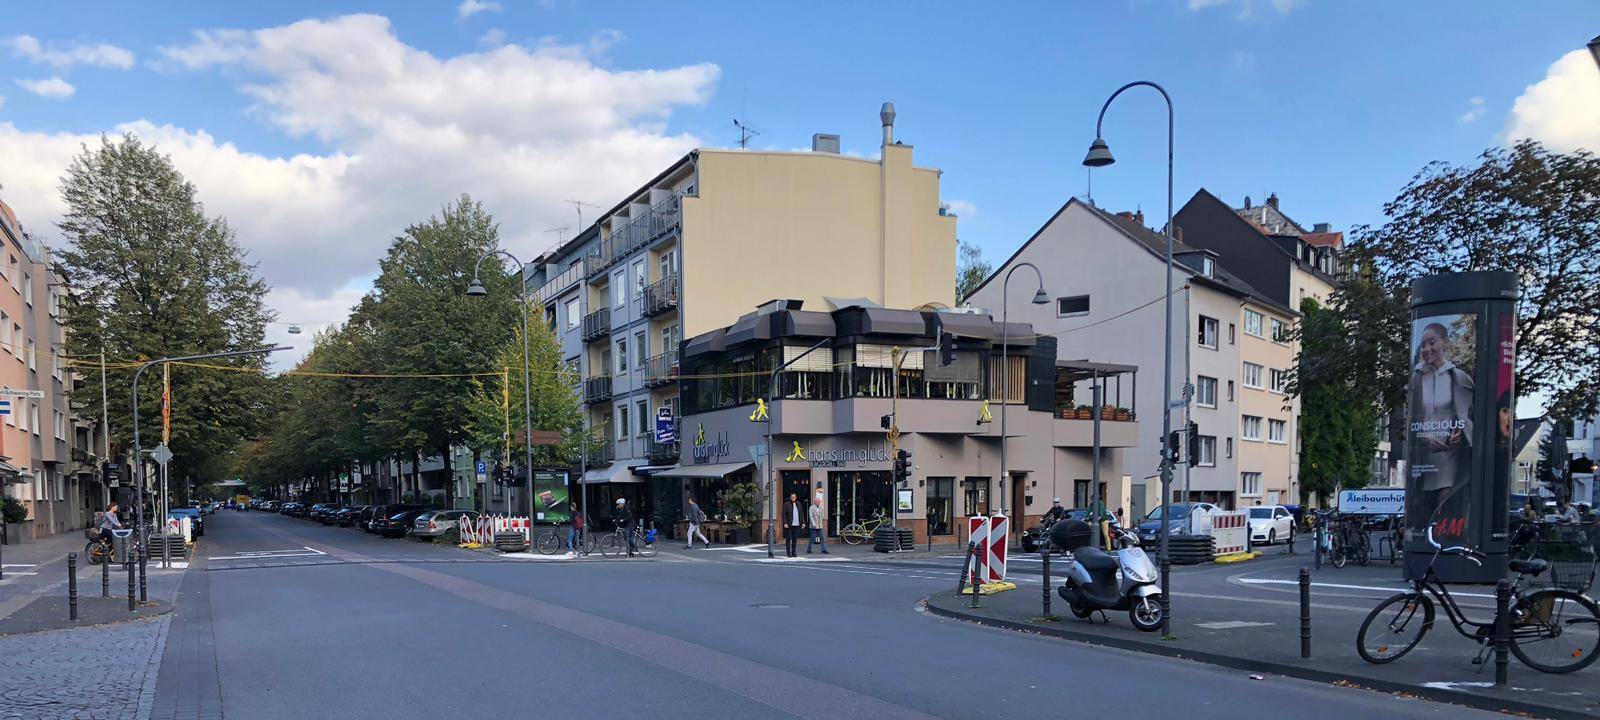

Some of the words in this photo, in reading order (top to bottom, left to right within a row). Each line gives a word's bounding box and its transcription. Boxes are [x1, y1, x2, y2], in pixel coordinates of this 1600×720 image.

[1410, 419, 1466, 432] CONSCIOUS
[808, 441, 838, 462] hans
[841, 447, 856, 462] im
[858, 439, 891, 467] glück
